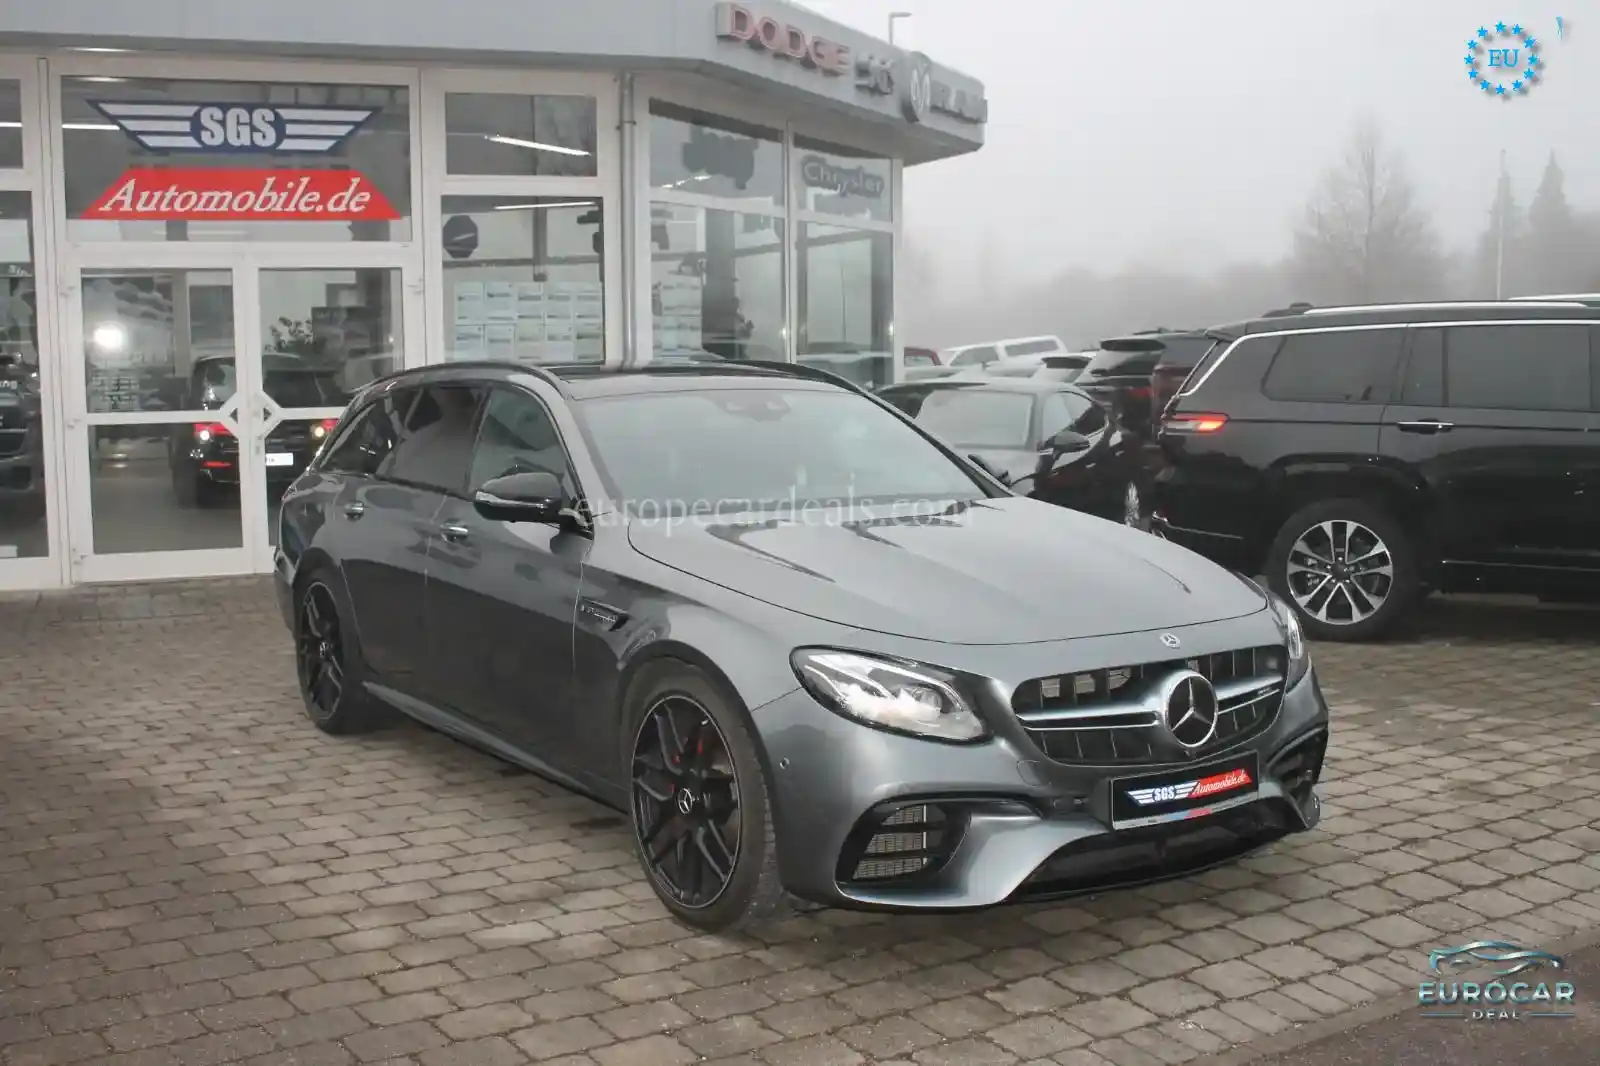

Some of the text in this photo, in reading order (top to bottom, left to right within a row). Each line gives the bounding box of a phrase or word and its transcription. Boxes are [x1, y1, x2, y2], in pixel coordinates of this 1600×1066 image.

[723, 4, 850, 75] DODGE
[199, 106, 277, 148] SGS
[98, 175, 371, 214] Automobile.de
[803, 160, 883, 197] Chrysler
[1154, 768, 1247, 801] SGS Automobile.de
